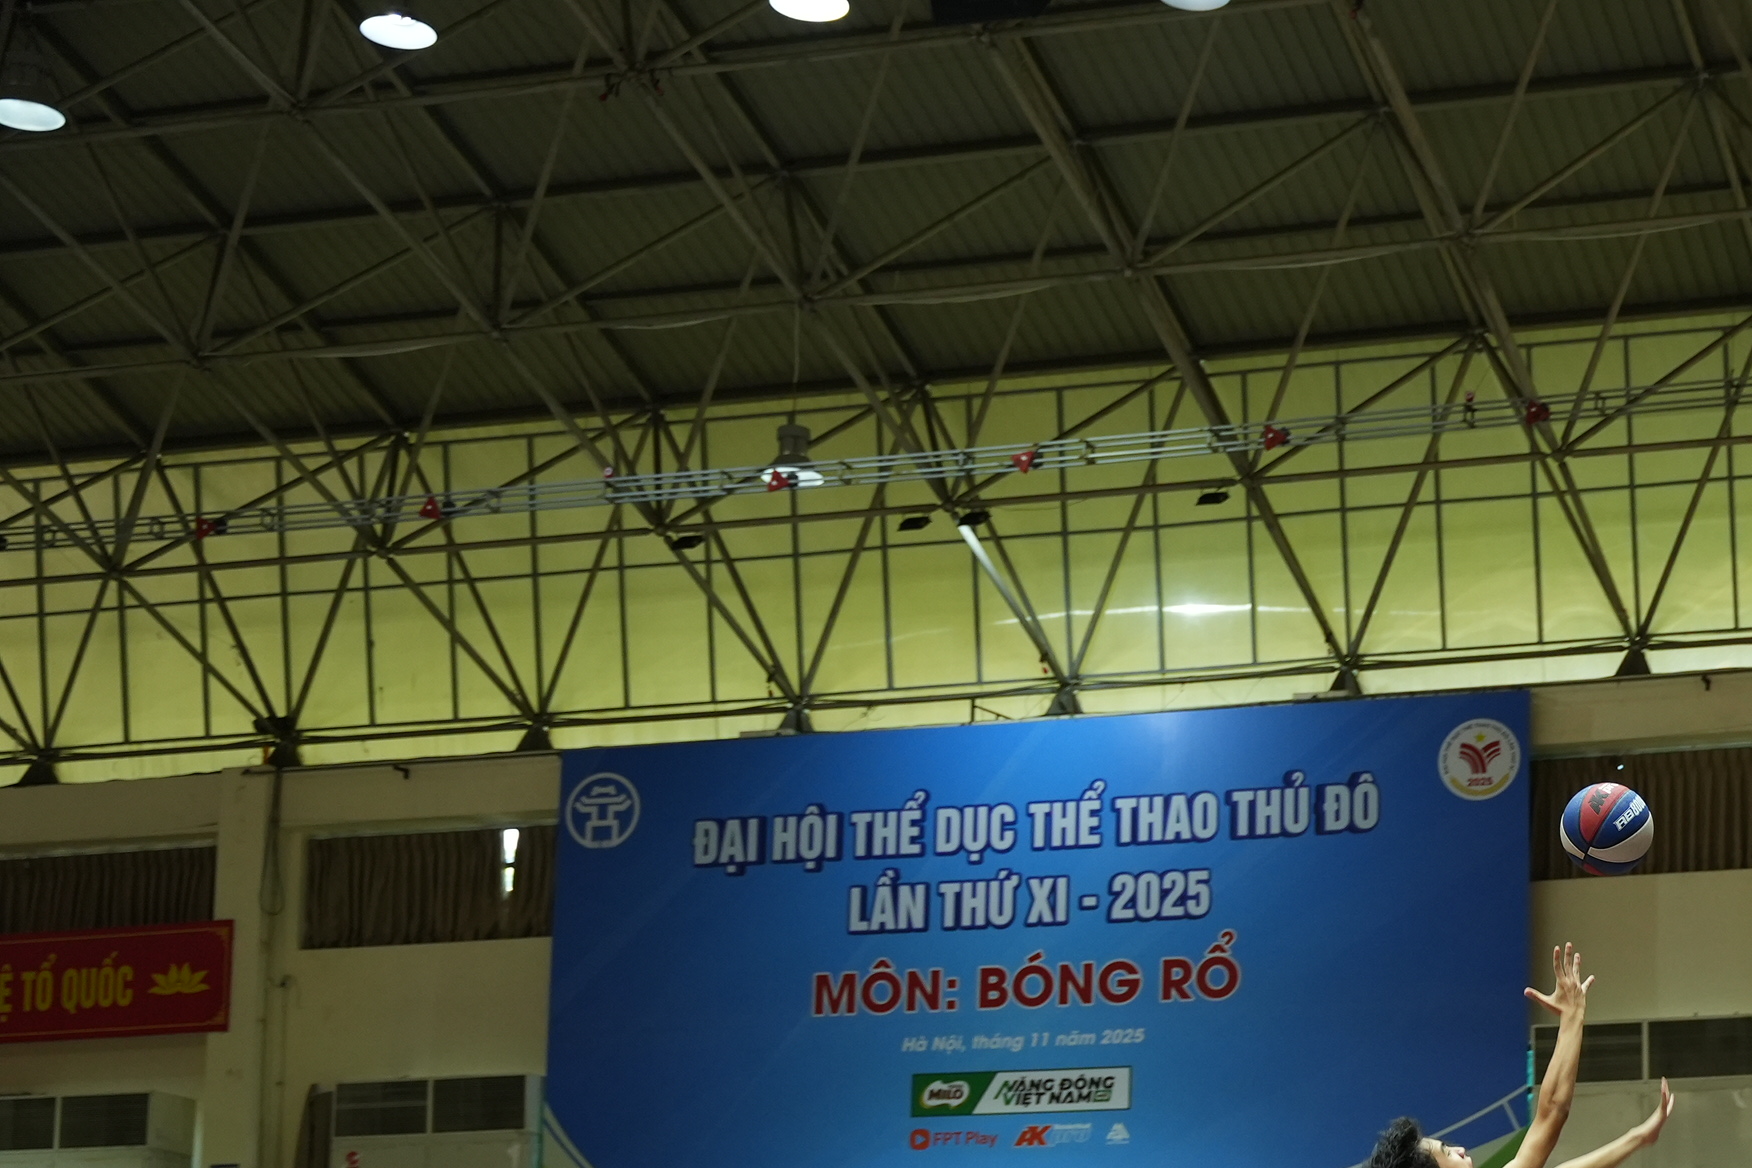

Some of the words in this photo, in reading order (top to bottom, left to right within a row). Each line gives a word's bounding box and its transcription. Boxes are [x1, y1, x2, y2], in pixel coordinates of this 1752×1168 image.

[693, 817, 763, 875] ĐẠI
[771, 804, 840, 873] HỘI
[850, 789, 926, 858] THỂ
[934, 802, 1016, 864] DỤC
[1028, 779, 1104, 850] THỂ
[1114, 791, 1219, 846] THAO
[1228, 770, 1310, 839] THỦ
[1317, 772, 1380, 835] ĐÔ
[849, 867, 928, 934] LẦN
[937, 868, 1020, 931] THỨ
[1025, 875, 1070, 926] XI
[1108, 869, 1212, 922] 2025
[21, 952, 57, 1013] TỔ
[61, 951, 134, 1015] QUỐC
[812, 957, 960, 1017] MÔN:
[976, 949, 1142, 1011] BÓNG
[1159, 928, 1240, 1002] RỔ
[1030, 1031, 1050, 1048] 11
[1100, 1028, 1145, 1045] 2025
[1047, 1090, 1093, 1106] NAM
